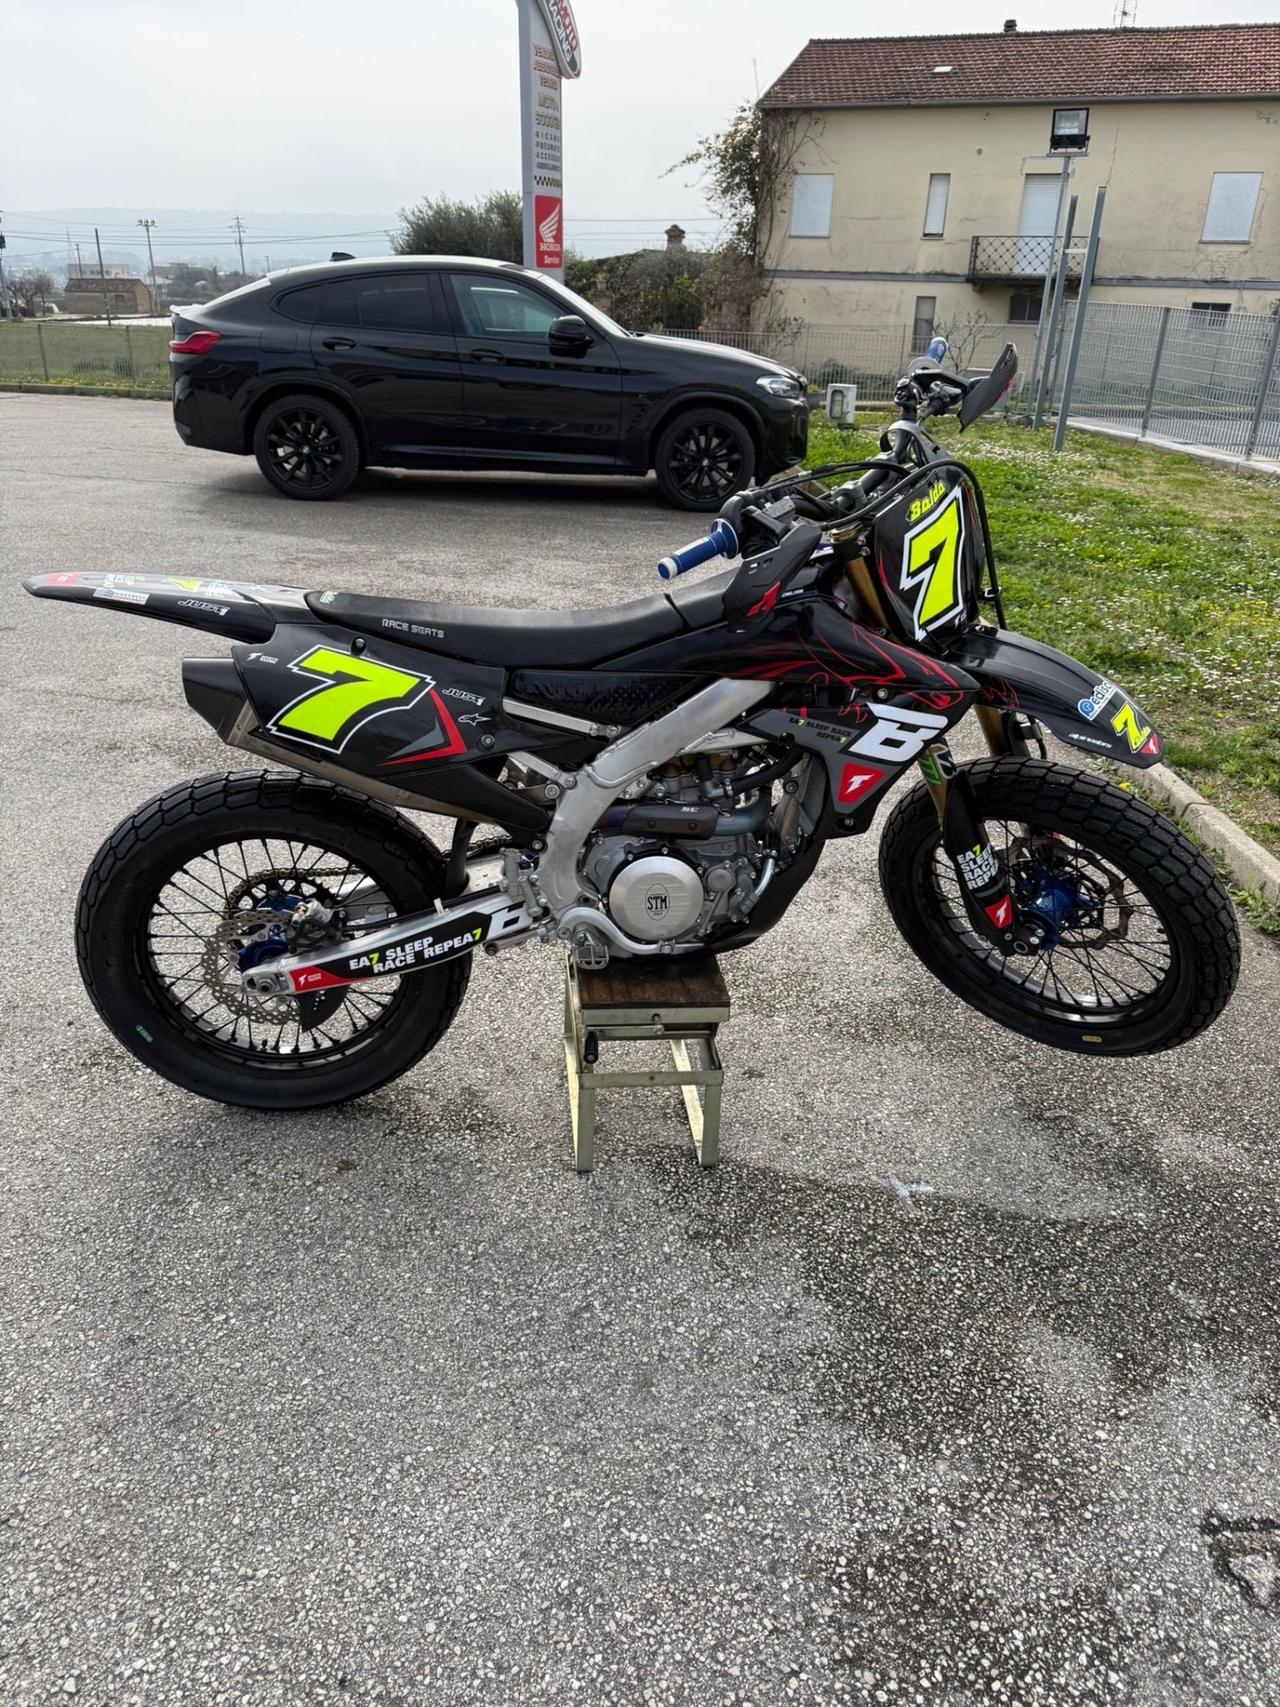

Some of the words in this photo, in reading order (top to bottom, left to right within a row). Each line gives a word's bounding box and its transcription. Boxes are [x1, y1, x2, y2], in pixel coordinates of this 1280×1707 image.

[539, 242, 561, 252] HONDA
[906, 495, 961, 632] 7
[381, 618, 409, 632] RACE
[411, 624, 445, 639] SEATS
[278, 648, 421, 741] 7
[806, 721, 830, 732] SLEEP
[831, 727, 853, 738] RACE
[957, 844, 981, 866] EA7
[647, 895, 668, 911] STM
[349, 953, 379, 970] EA7
[385, 936, 434, 960] SLEEP
[373, 953, 416, 974] RACE
[423, 927, 482, 959] REPEA7
